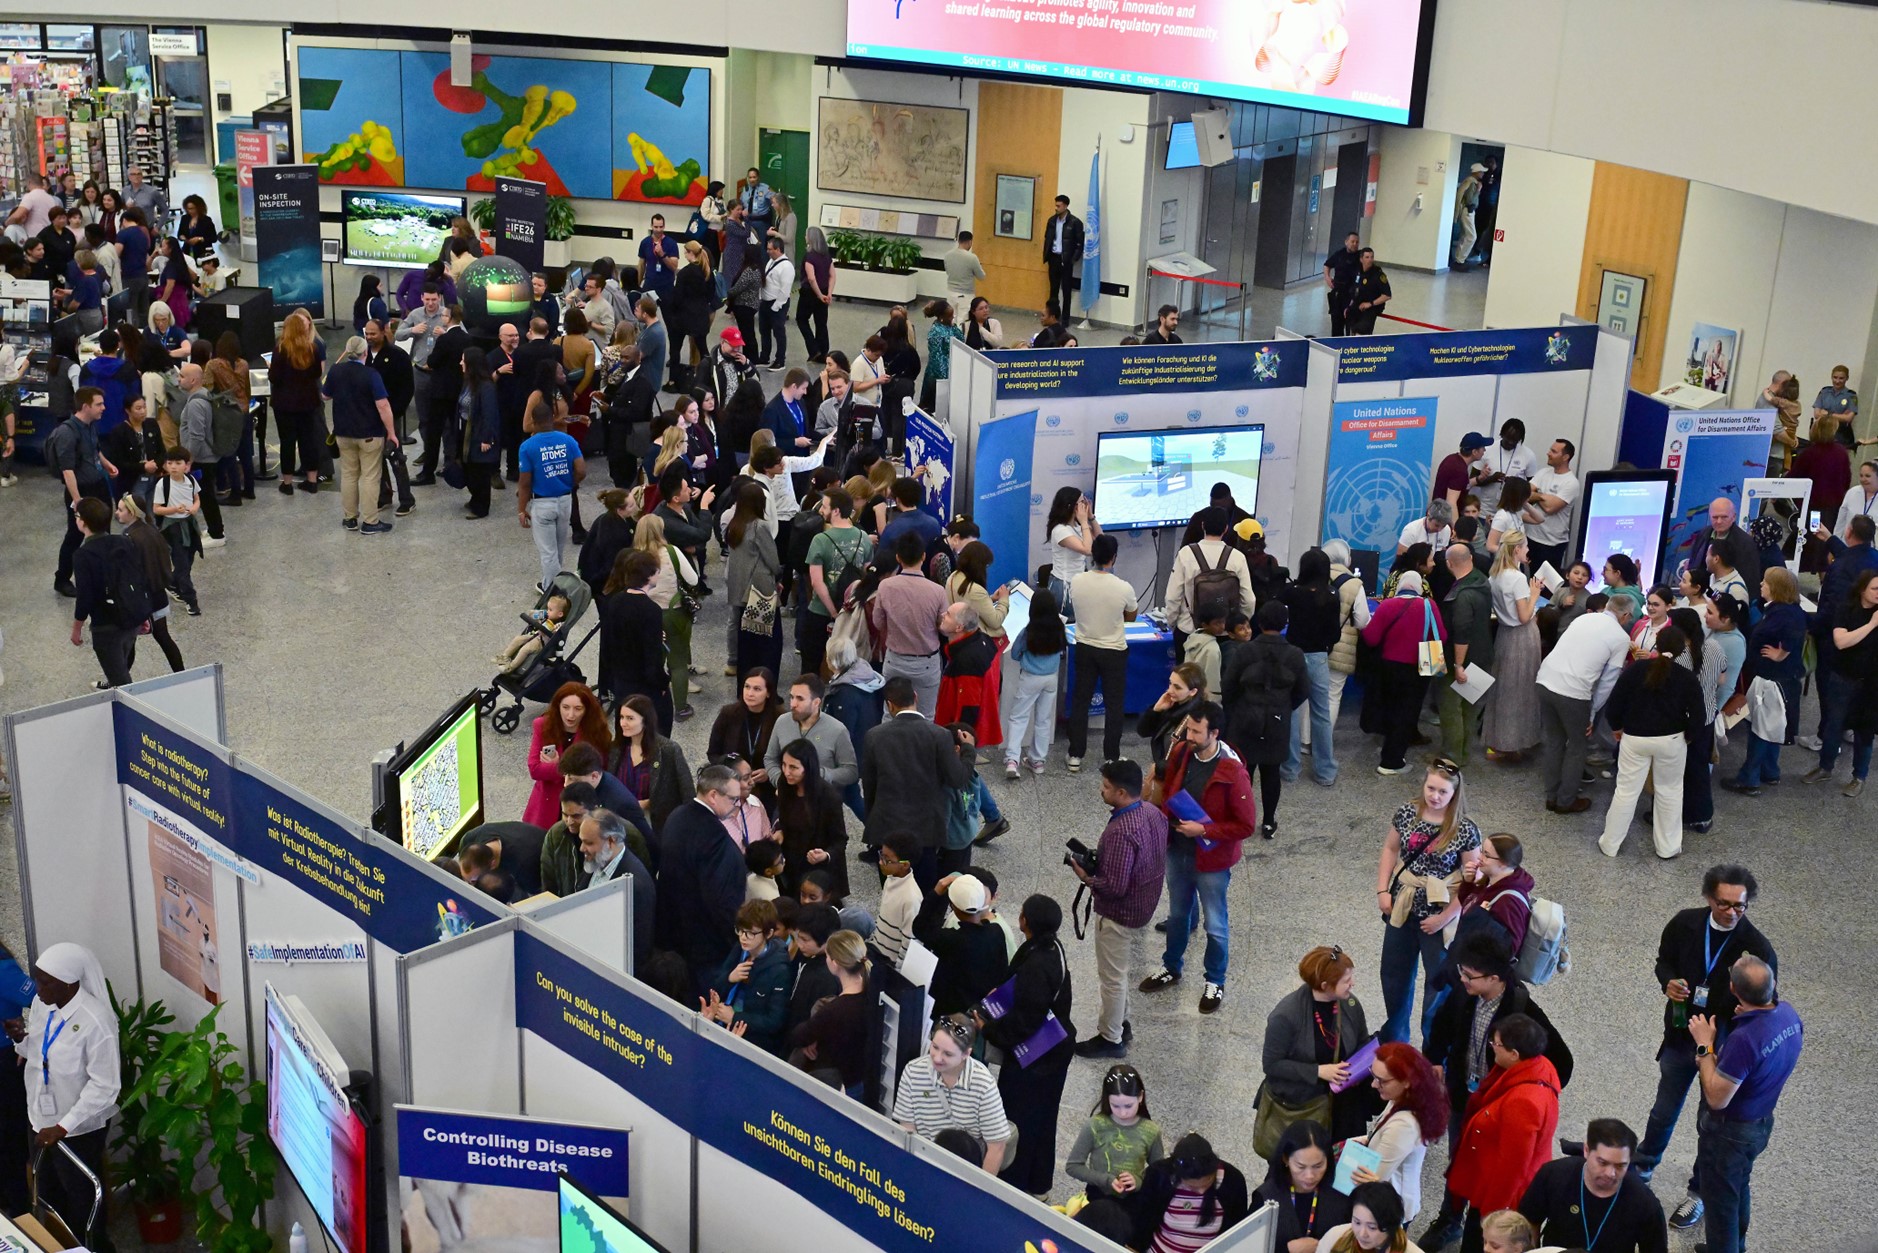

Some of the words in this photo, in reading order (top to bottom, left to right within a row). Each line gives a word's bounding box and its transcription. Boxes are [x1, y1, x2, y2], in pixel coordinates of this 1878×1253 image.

[1122, 0, 1173, 17] innovation
[1177, 5, 1196, 18] and
[945, 3, 979, 16] shared
[981, 5, 1022, 23] learning
[1024, 11, 1056, 24] across
[1060, 12, 1075, 25] the
[1077, 13, 1108, 28] global
[1110, 18, 1161, 36] regulatory
[1163, 24, 1219, 41] community.
[963, 56, 1001, 67] Source:
[1008, 60, 1019, 70] UN
[1025, 62, 1047, 72] News
[1064, 66, 1087, 77] Read
[1092, 70, 1115, 80] more
[1120, 73, 1132, 83] at
[1137, 75, 1200, 92] news.un.org
[237, 135, 259, 143] Vienna
[238, 144, 260, 152] Service
[259, 193, 288, 201] ON-SITE
[259, 200, 301, 208] INSPECTION
[511, 223, 535, 235] IFE26
[1344, 347, 1359, 355] cyber
[1360, 345, 1395, 354] technologies
[1430, 347, 1450, 355] Machen
[1457, 346, 1467, 354] und
[1468, 344, 1515, 354] Cybertechnologien
[1011, 360, 1038, 368] research
[1040, 359, 1051, 367] and
[1060, 359, 1084, 367] support
[1134, 356, 1156, 364] können
[1157, 355, 1187, 364] Forschung
[1208, 354, 1217, 362] die
[1363, 356, 1387, 365] weapons
[1433, 355, 1473, 364] Nuklearwaffen
[1473, 353, 1508, 364] gefährlicher?
[1010, 370, 1059, 379] industrialization
[1067, 369, 1078, 377] the
[1121, 366, 1153, 375] zukünftige
[1154, 365, 1206, 374] Industrialisierung
[1345, 366, 1377, 374] dangerous?
[1005, 381, 1038, 390] developing
[1040, 380, 1061, 388] world?
[1119, 377, 1176, 385] Entwicklungsländer
[1177, 375, 1218, 383] unterstützen?
[1354, 408, 1382, 418] United
[1384, 406, 1417, 416] Nations
[1349, 421, 1367, 429] Office
[1369, 420, 1377, 428] for
[1378, 419, 1419, 427] Disarmament
[1699, 417, 1718, 425] United
[1719, 416, 1741, 424] Nations
[1707, 425, 1746, 433] Disarmament
[1747, 424, 1767, 432] Affairs
[1372, 431, 1393, 439] Affairs
[141, 732, 156, 750] What
[158, 742, 164, 755] is
[165, 749, 209, 782] radiotherapy?
[141, 750, 156, 768] Step
[157, 758, 168, 775] into
[170, 766, 181, 782] the
[181, 773, 202, 795] future
[202, 788, 210, 800] of
[129, 762, 150, 780] cancer
[152, 774, 167, 790] care
[167, 781, 181, 799] with
[181, 791, 202, 814] virtual
[202, 806, 226, 829] reality!
[267, 805, 282, 824] Was
[283, 813, 293, 831] ist
[294, 820, 347, 861] Radiotherapie?
[348, 851, 370, 877] Treten
[373, 867, 385, 884] Sie
[268, 827, 280, 842] mit
[281, 832, 306, 857] Virtual
[307, 847, 333, 875] Reality
[334, 861, 342, 877] in
[343, 869, 355, 885] die
[355, 875, 385, 904] Zukunft
[282, 852, 294, 867] der
[296, 859, 358, 909] Krebsbehandlung
[358, 899, 371, 916] ein!
[248, 943, 366, 963] #SafeImplementationOfAI
[536, 971, 553, 992] Can
[556, 985, 572, 1003] you
[574, 996, 599, 1019] solve
[601, 1010, 616, 1030] the
[619, 1023, 643, 1045] case
[644, 1039, 655, 1053] of
[657, 1045, 673, 1065] the
[563, 1007, 601, 1041] invisible
[602, 1031, 645, 1069] intruder?
[423, 1127, 530, 1153] Controlling
[535, 1138, 613, 1158] Disease
[467, 1151, 568, 1173] Biothreats
[770, 1110, 811, 1147] Können
[814, 1135, 831, 1158] Sie
[834, 1149, 856, 1173] den
[859, 1162, 881, 1188] Fall
[884, 1179, 906, 1203] des
[744, 1120, 815, 1172] unsichtbaren
[818, 1162, 891, 1218] Eindringlings
[894, 1207, 935, 1243] lösen?
